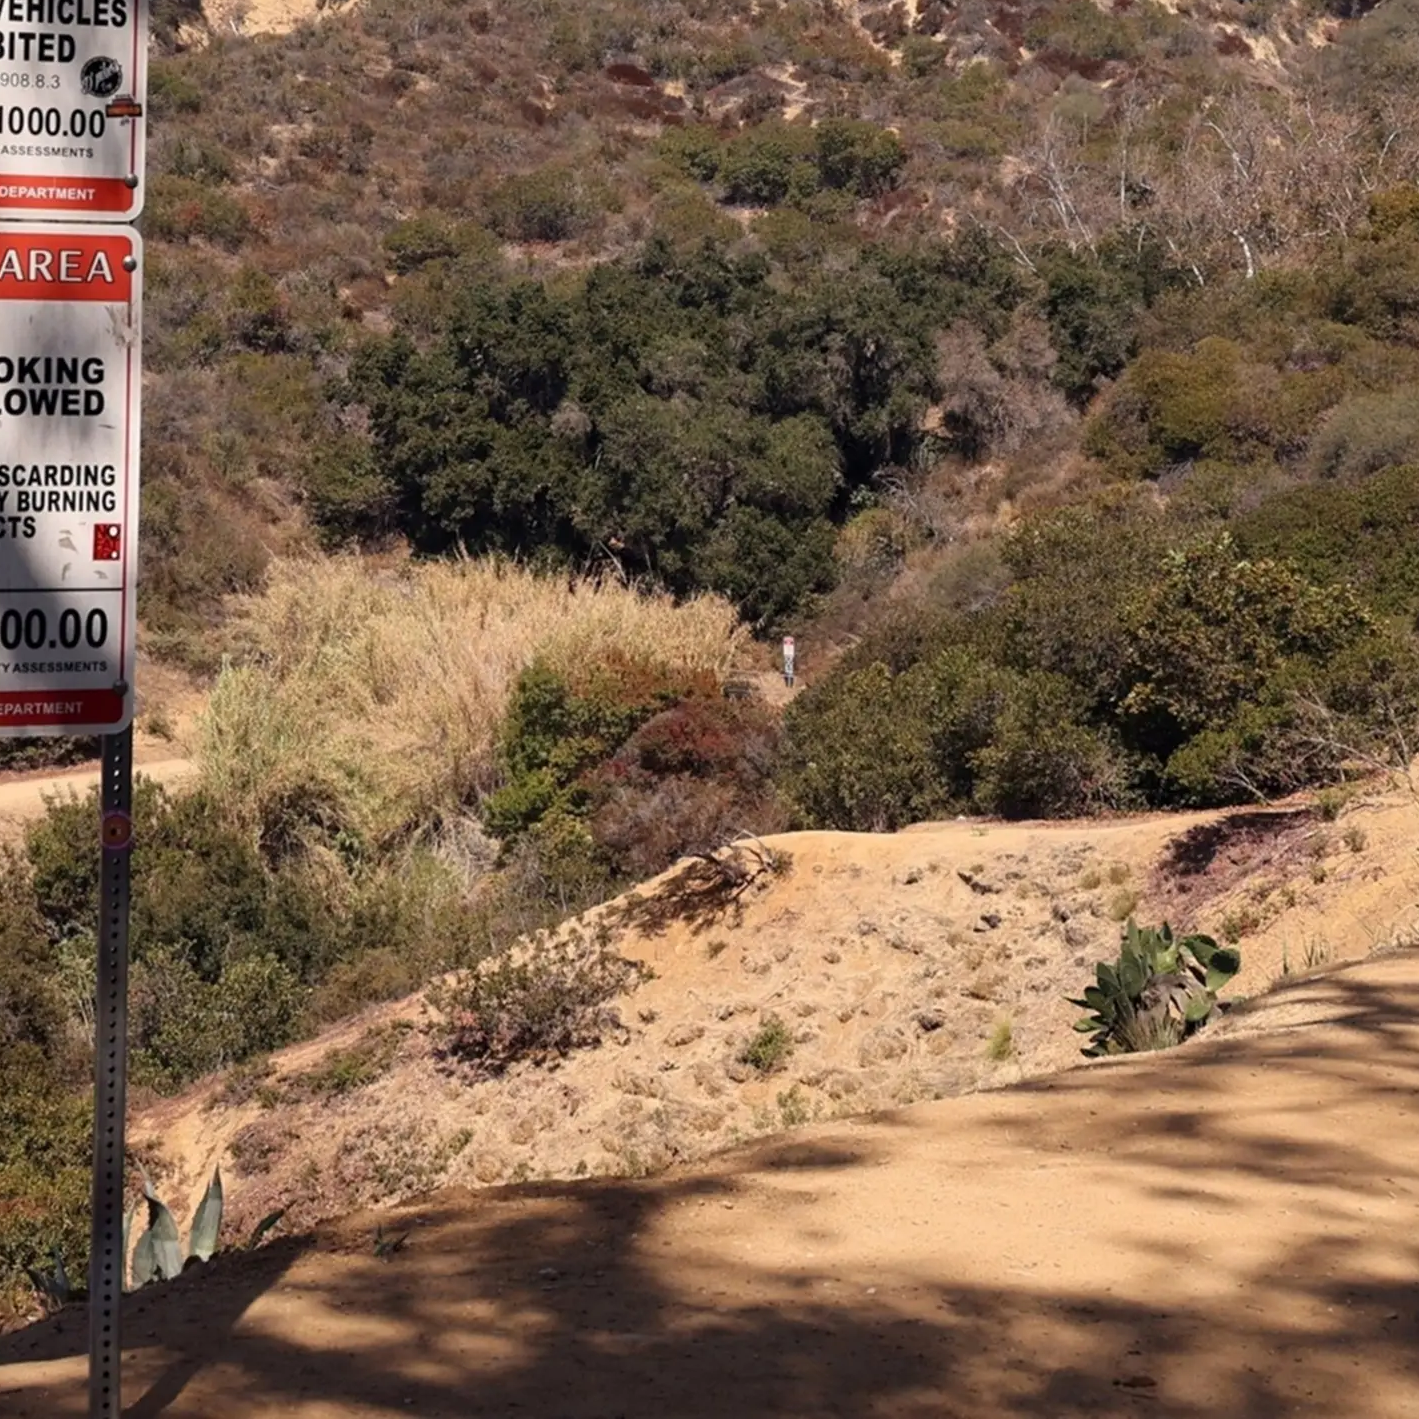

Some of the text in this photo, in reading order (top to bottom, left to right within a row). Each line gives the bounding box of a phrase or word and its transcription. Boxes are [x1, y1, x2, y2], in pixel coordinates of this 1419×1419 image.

[1, 145, 94, 159] ASSESSMENTS
[0, 186, 95, 200] DEPARTMENT
[17, 490, 116, 512] BURNING
[12, 661, 108, 674] ASSESSMENTS
